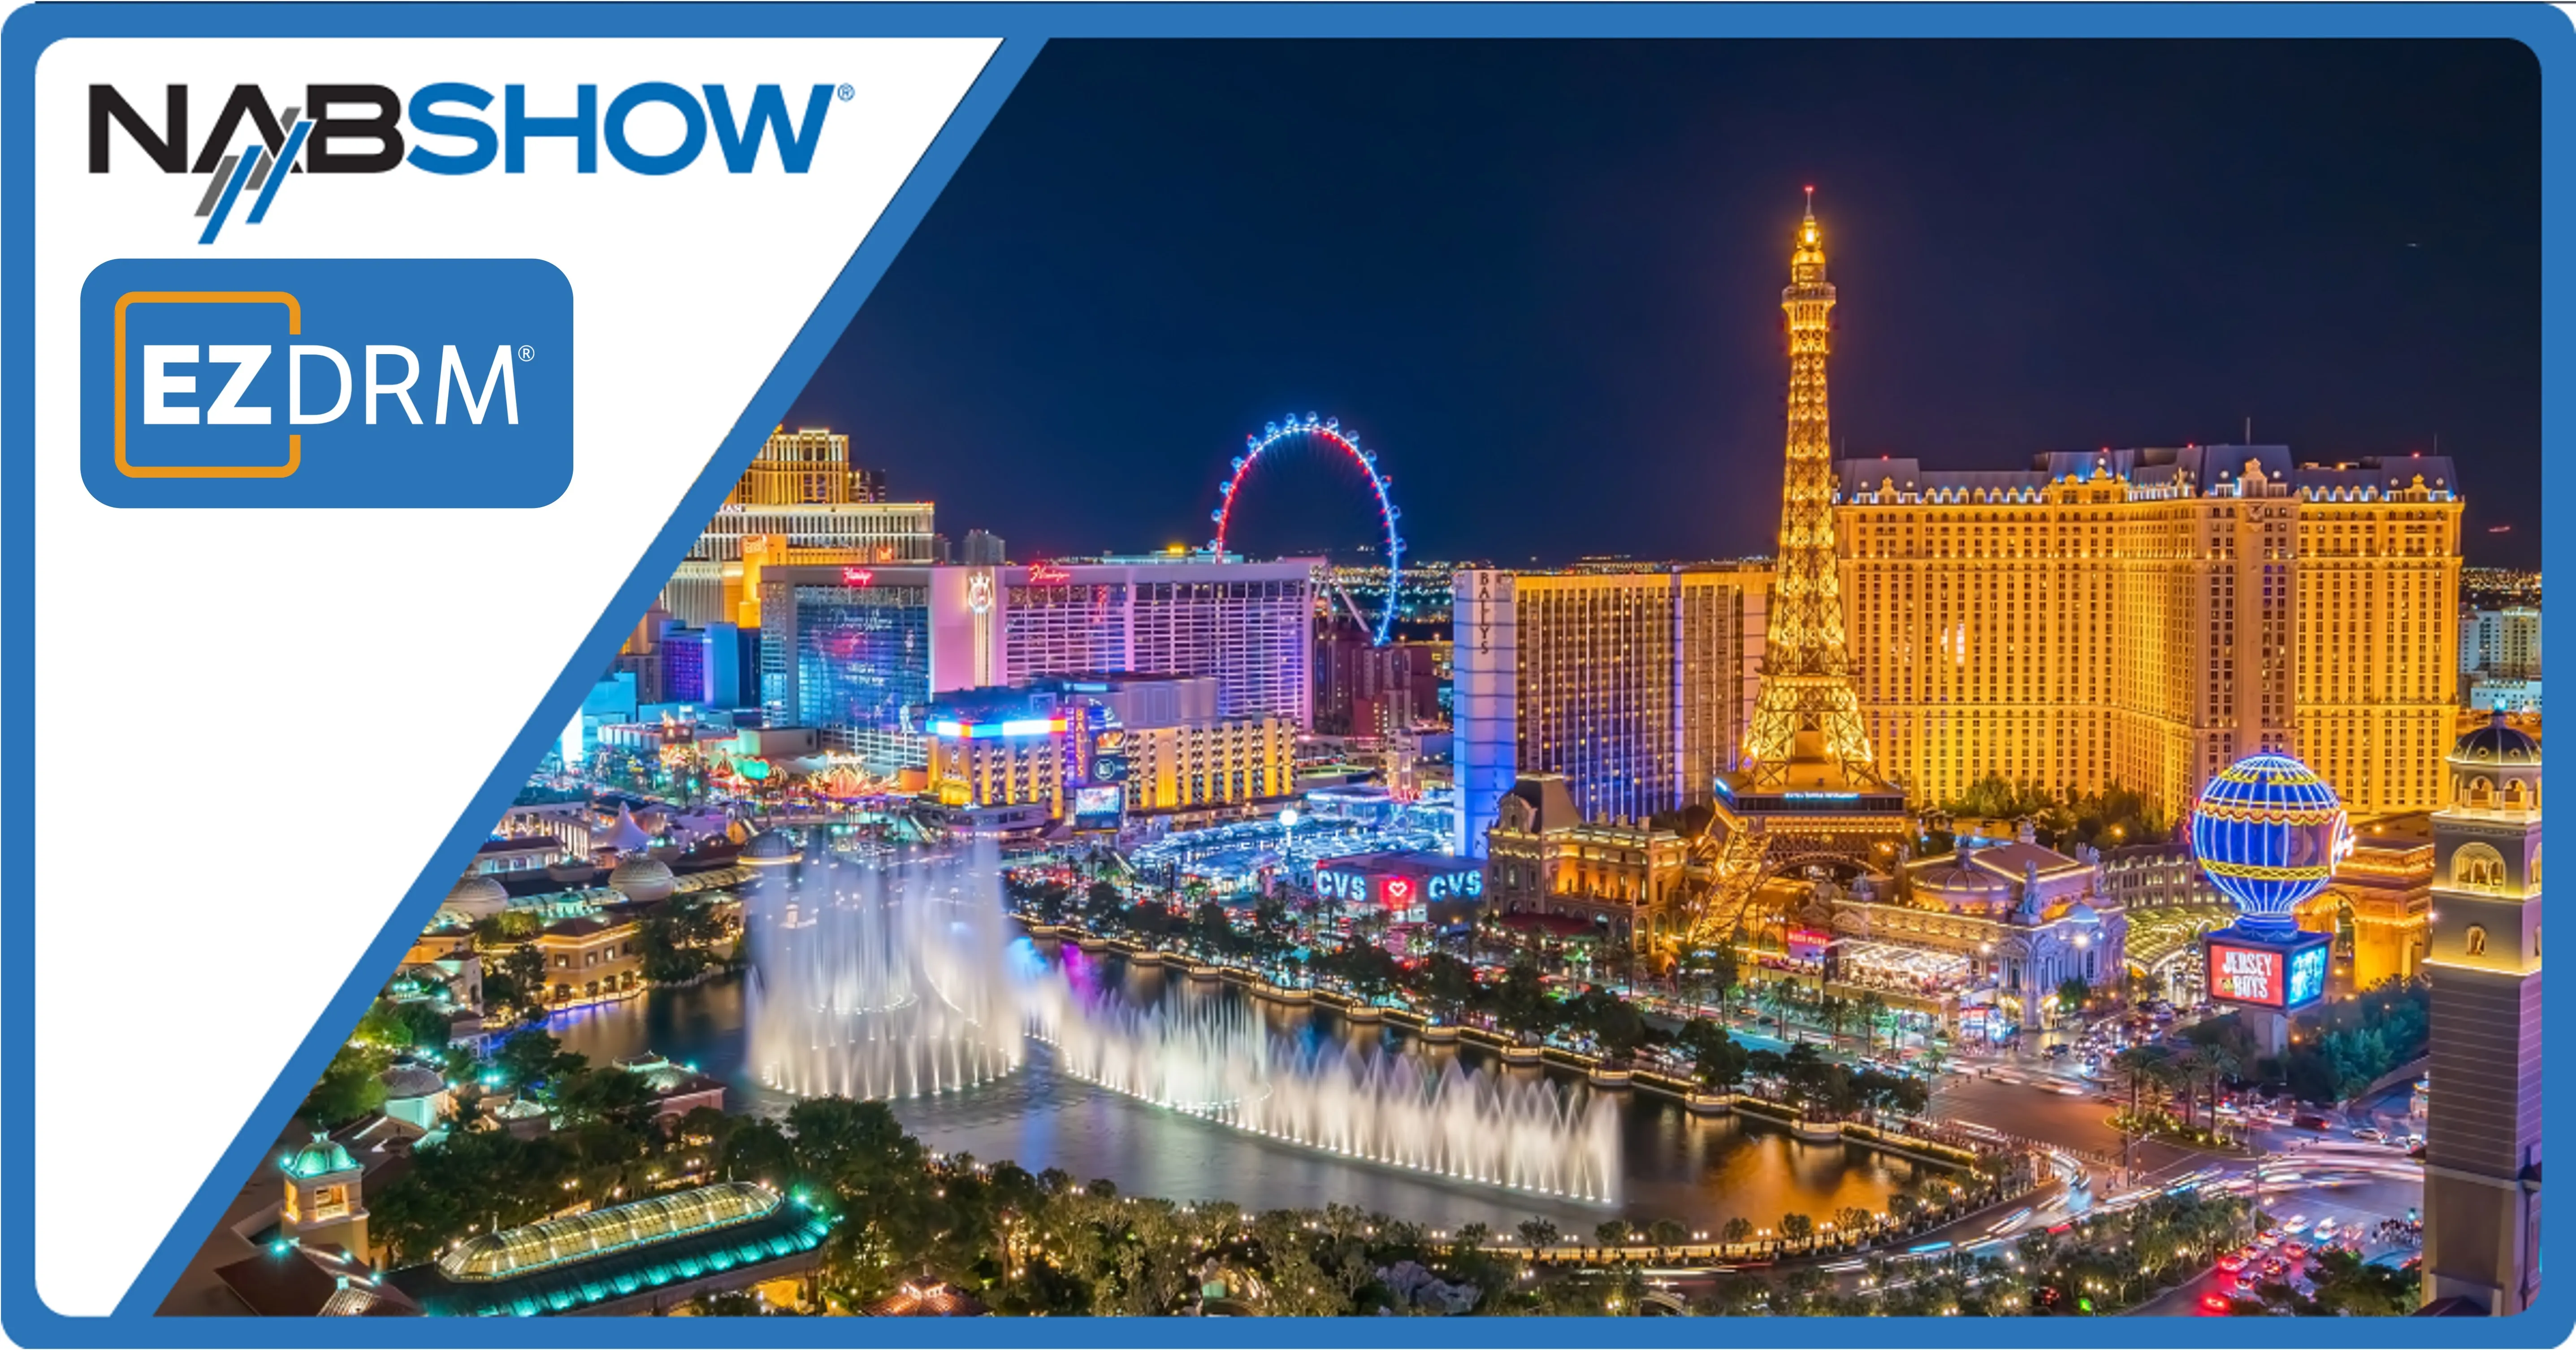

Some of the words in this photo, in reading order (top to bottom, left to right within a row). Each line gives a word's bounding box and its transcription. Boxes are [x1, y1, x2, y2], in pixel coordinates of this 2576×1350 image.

[1317, 870, 1367, 902] CVS
[1429, 870, 1484, 902] CVS
[2221, 951, 2273, 977] JERSEY
[2232, 974, 2269, 999] BOYS
